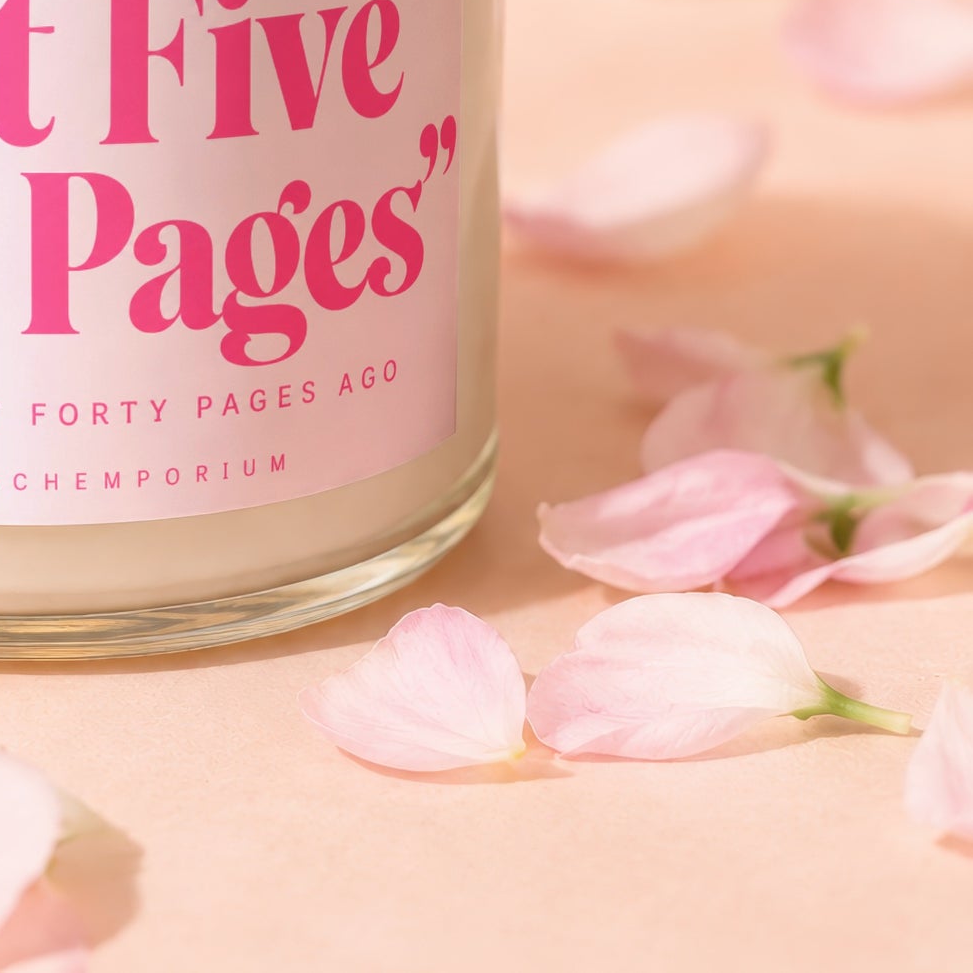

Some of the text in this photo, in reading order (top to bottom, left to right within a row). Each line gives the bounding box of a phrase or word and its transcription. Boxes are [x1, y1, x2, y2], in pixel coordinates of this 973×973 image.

[20, 115, 457, 367] Pages”
[31, 398, 167, 427] FORTY
[195, 380, 318, 420] PAGES
[339, 359, 399, 396] AGO
